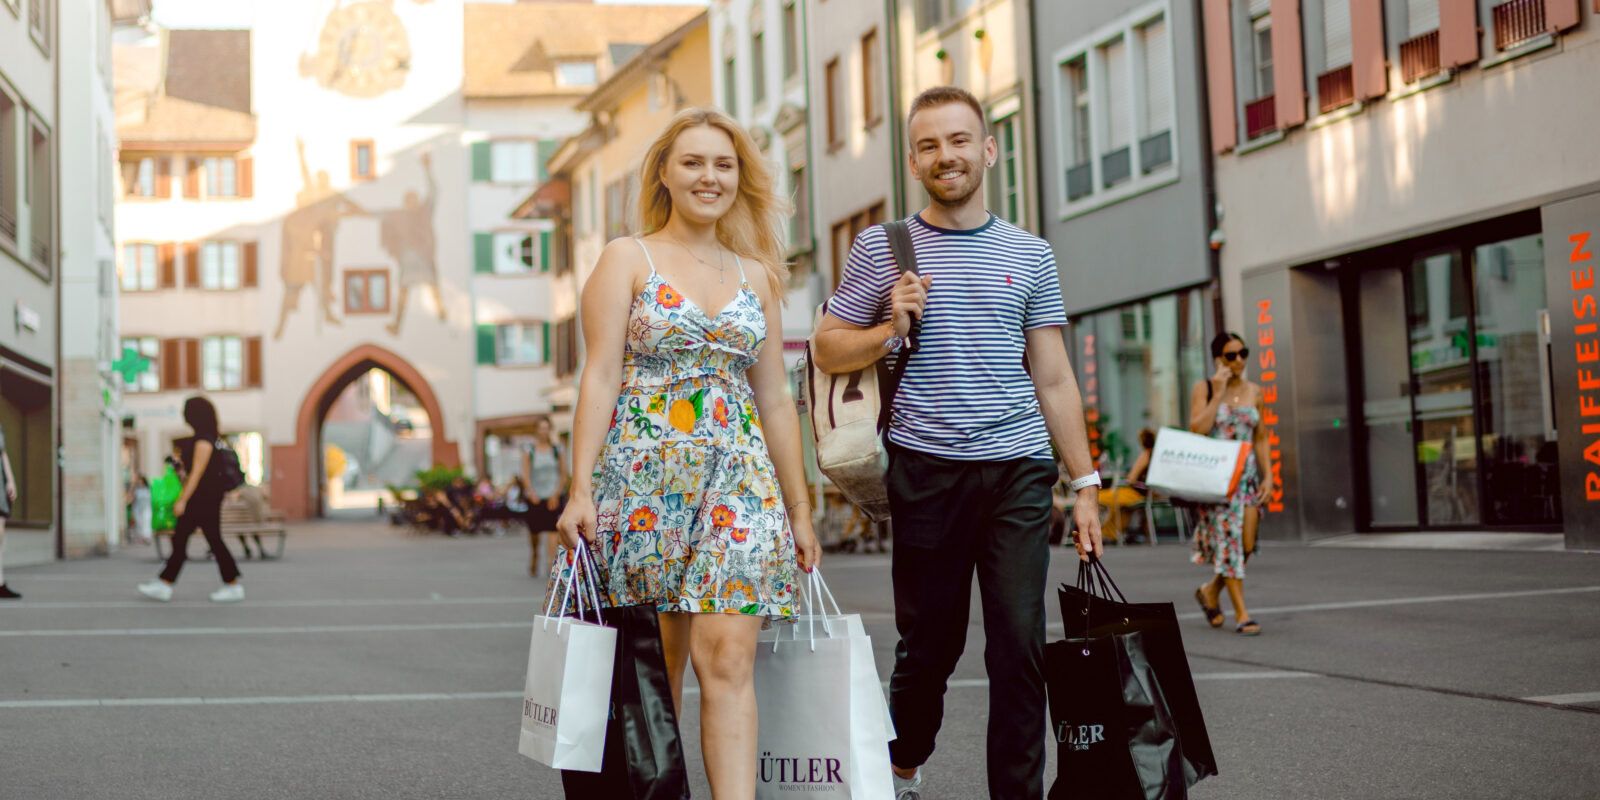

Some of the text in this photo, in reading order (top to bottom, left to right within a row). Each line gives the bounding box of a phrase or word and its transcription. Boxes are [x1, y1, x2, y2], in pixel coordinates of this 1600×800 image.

[1569, 232, 1600, 501] RAIFFEISEN
[524, 698, 557, 726] BÜTLER
[757, 751, 844, 783] ÜTLER
[807, 784, 835, 792] FASHION
